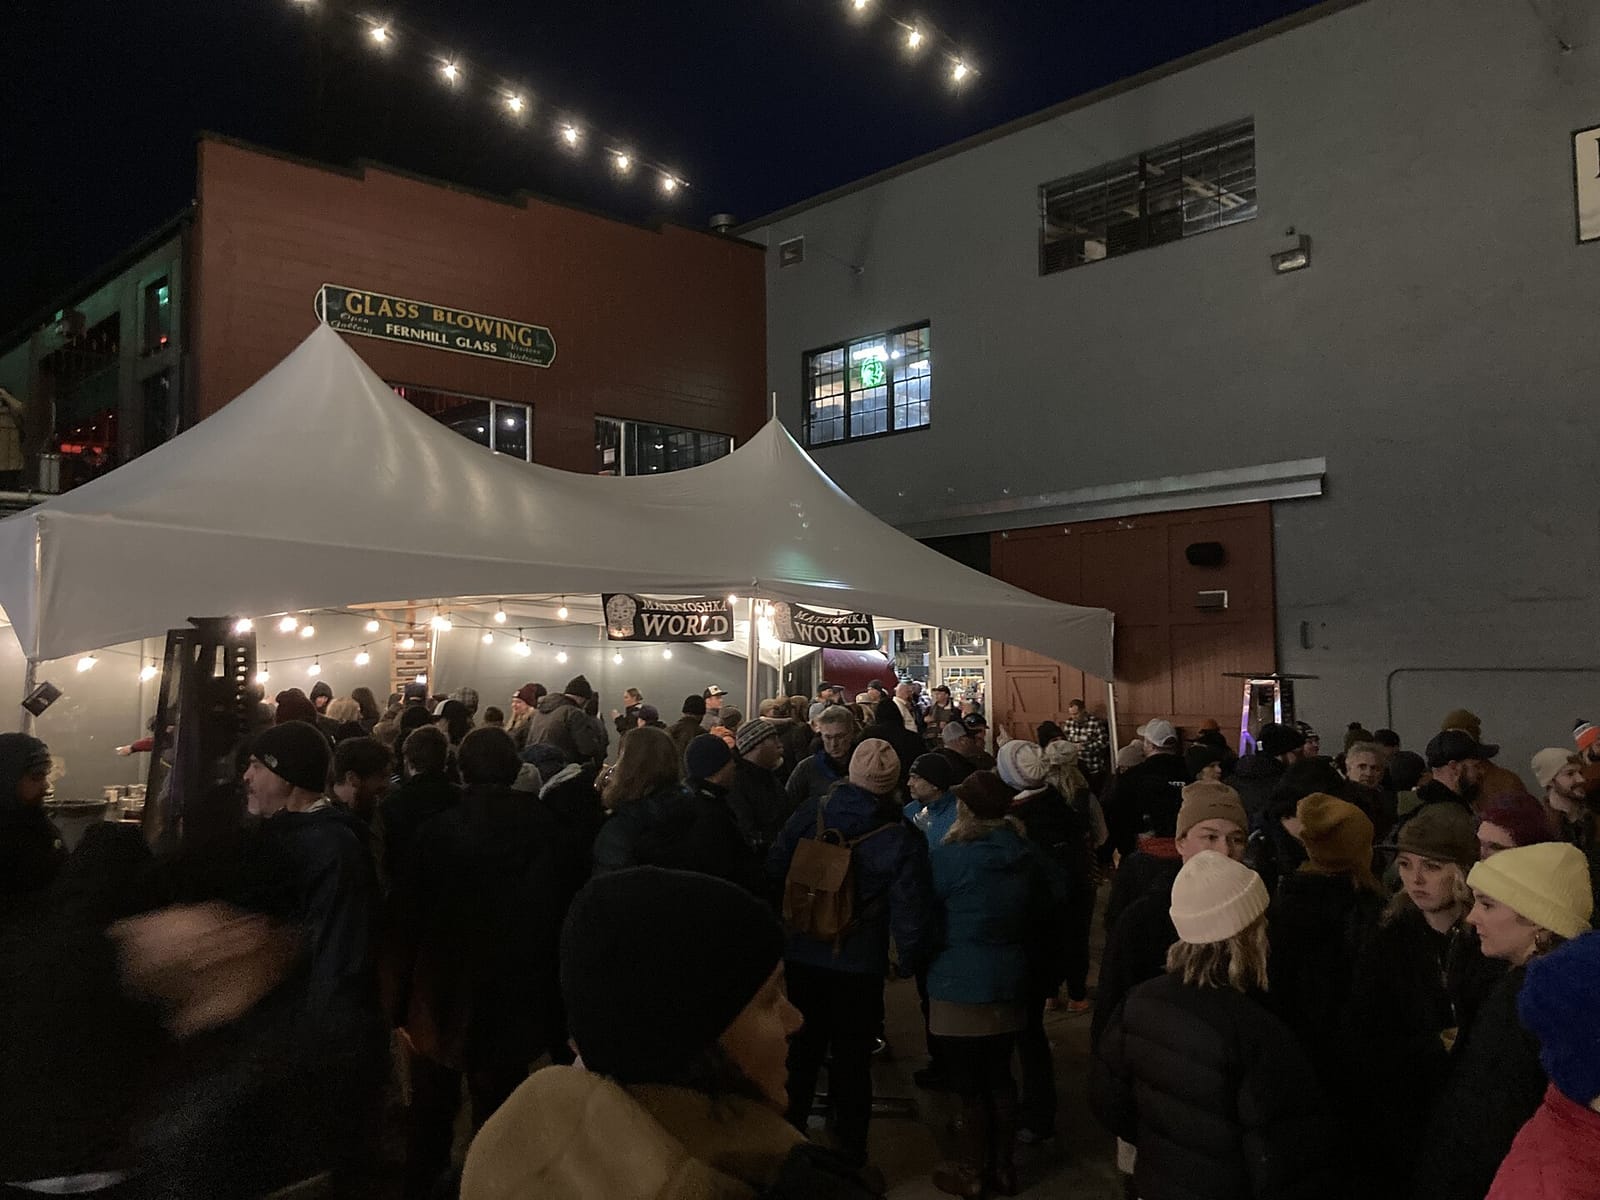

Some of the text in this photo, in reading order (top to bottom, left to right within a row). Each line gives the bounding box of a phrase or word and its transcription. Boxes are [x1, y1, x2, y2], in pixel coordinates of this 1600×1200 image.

[345, 292, 533, 347] GLASS BLOWING
[385, 322, 498, 353] FERNHILL GLASS
[641, 599, 728, 613] MATRYOSHKA
[640, 613, 729, 637] WORLD
[794, 622, 871, 645] WORLD
